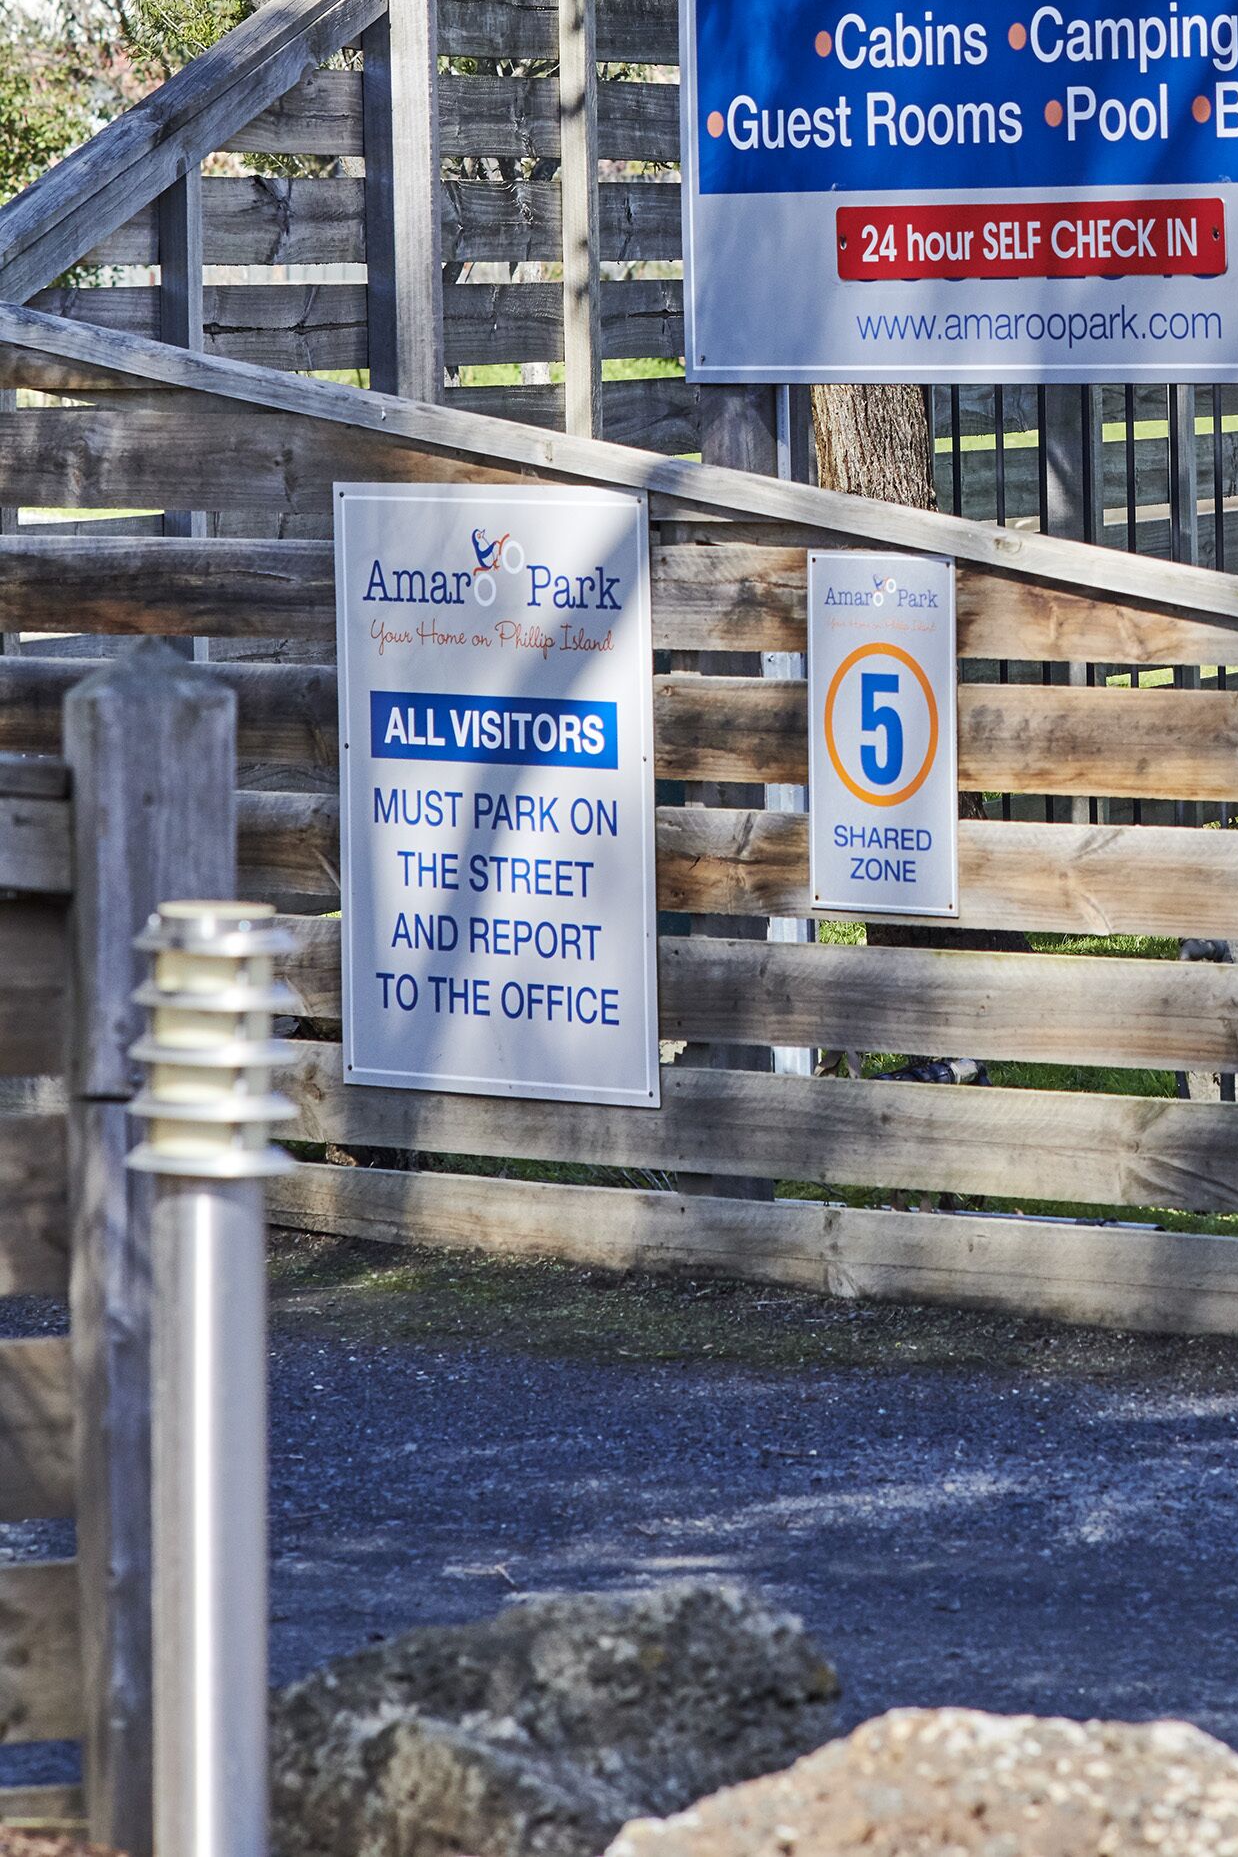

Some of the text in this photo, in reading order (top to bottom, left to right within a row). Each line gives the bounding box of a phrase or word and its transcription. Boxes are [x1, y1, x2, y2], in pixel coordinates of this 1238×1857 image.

[833, 11, 988, 70] Cabins
[726, 95, 852, 151] Guest
[867, 92, 1023, 146] Rooms
[1066, 83, 1170, 142] Pool
[861, 217, 1198, 263] 24 hour SELF CHECK IN
[856, 304, 1223, 349] www.amaroopark.com
[527, 565, 622, 610] Park
[897, 589, 939, 608] Park
[370, 618, 616, 659] Your Home on Phillip Island
[383, 706, 605, 756] ALL VISITORS
[860, 672, 903, 786] 5
[373, 787, 618, 837] MUST PARK ON
[833, 824, 932, 851] SHARED
[397, 851, 594, 898] THE STREET
[850, 858, 917, 883] ZONE
[391, 912, 602, 962] AND REPORT
[376, 972, 620, 1025] TO THE OFFICE
